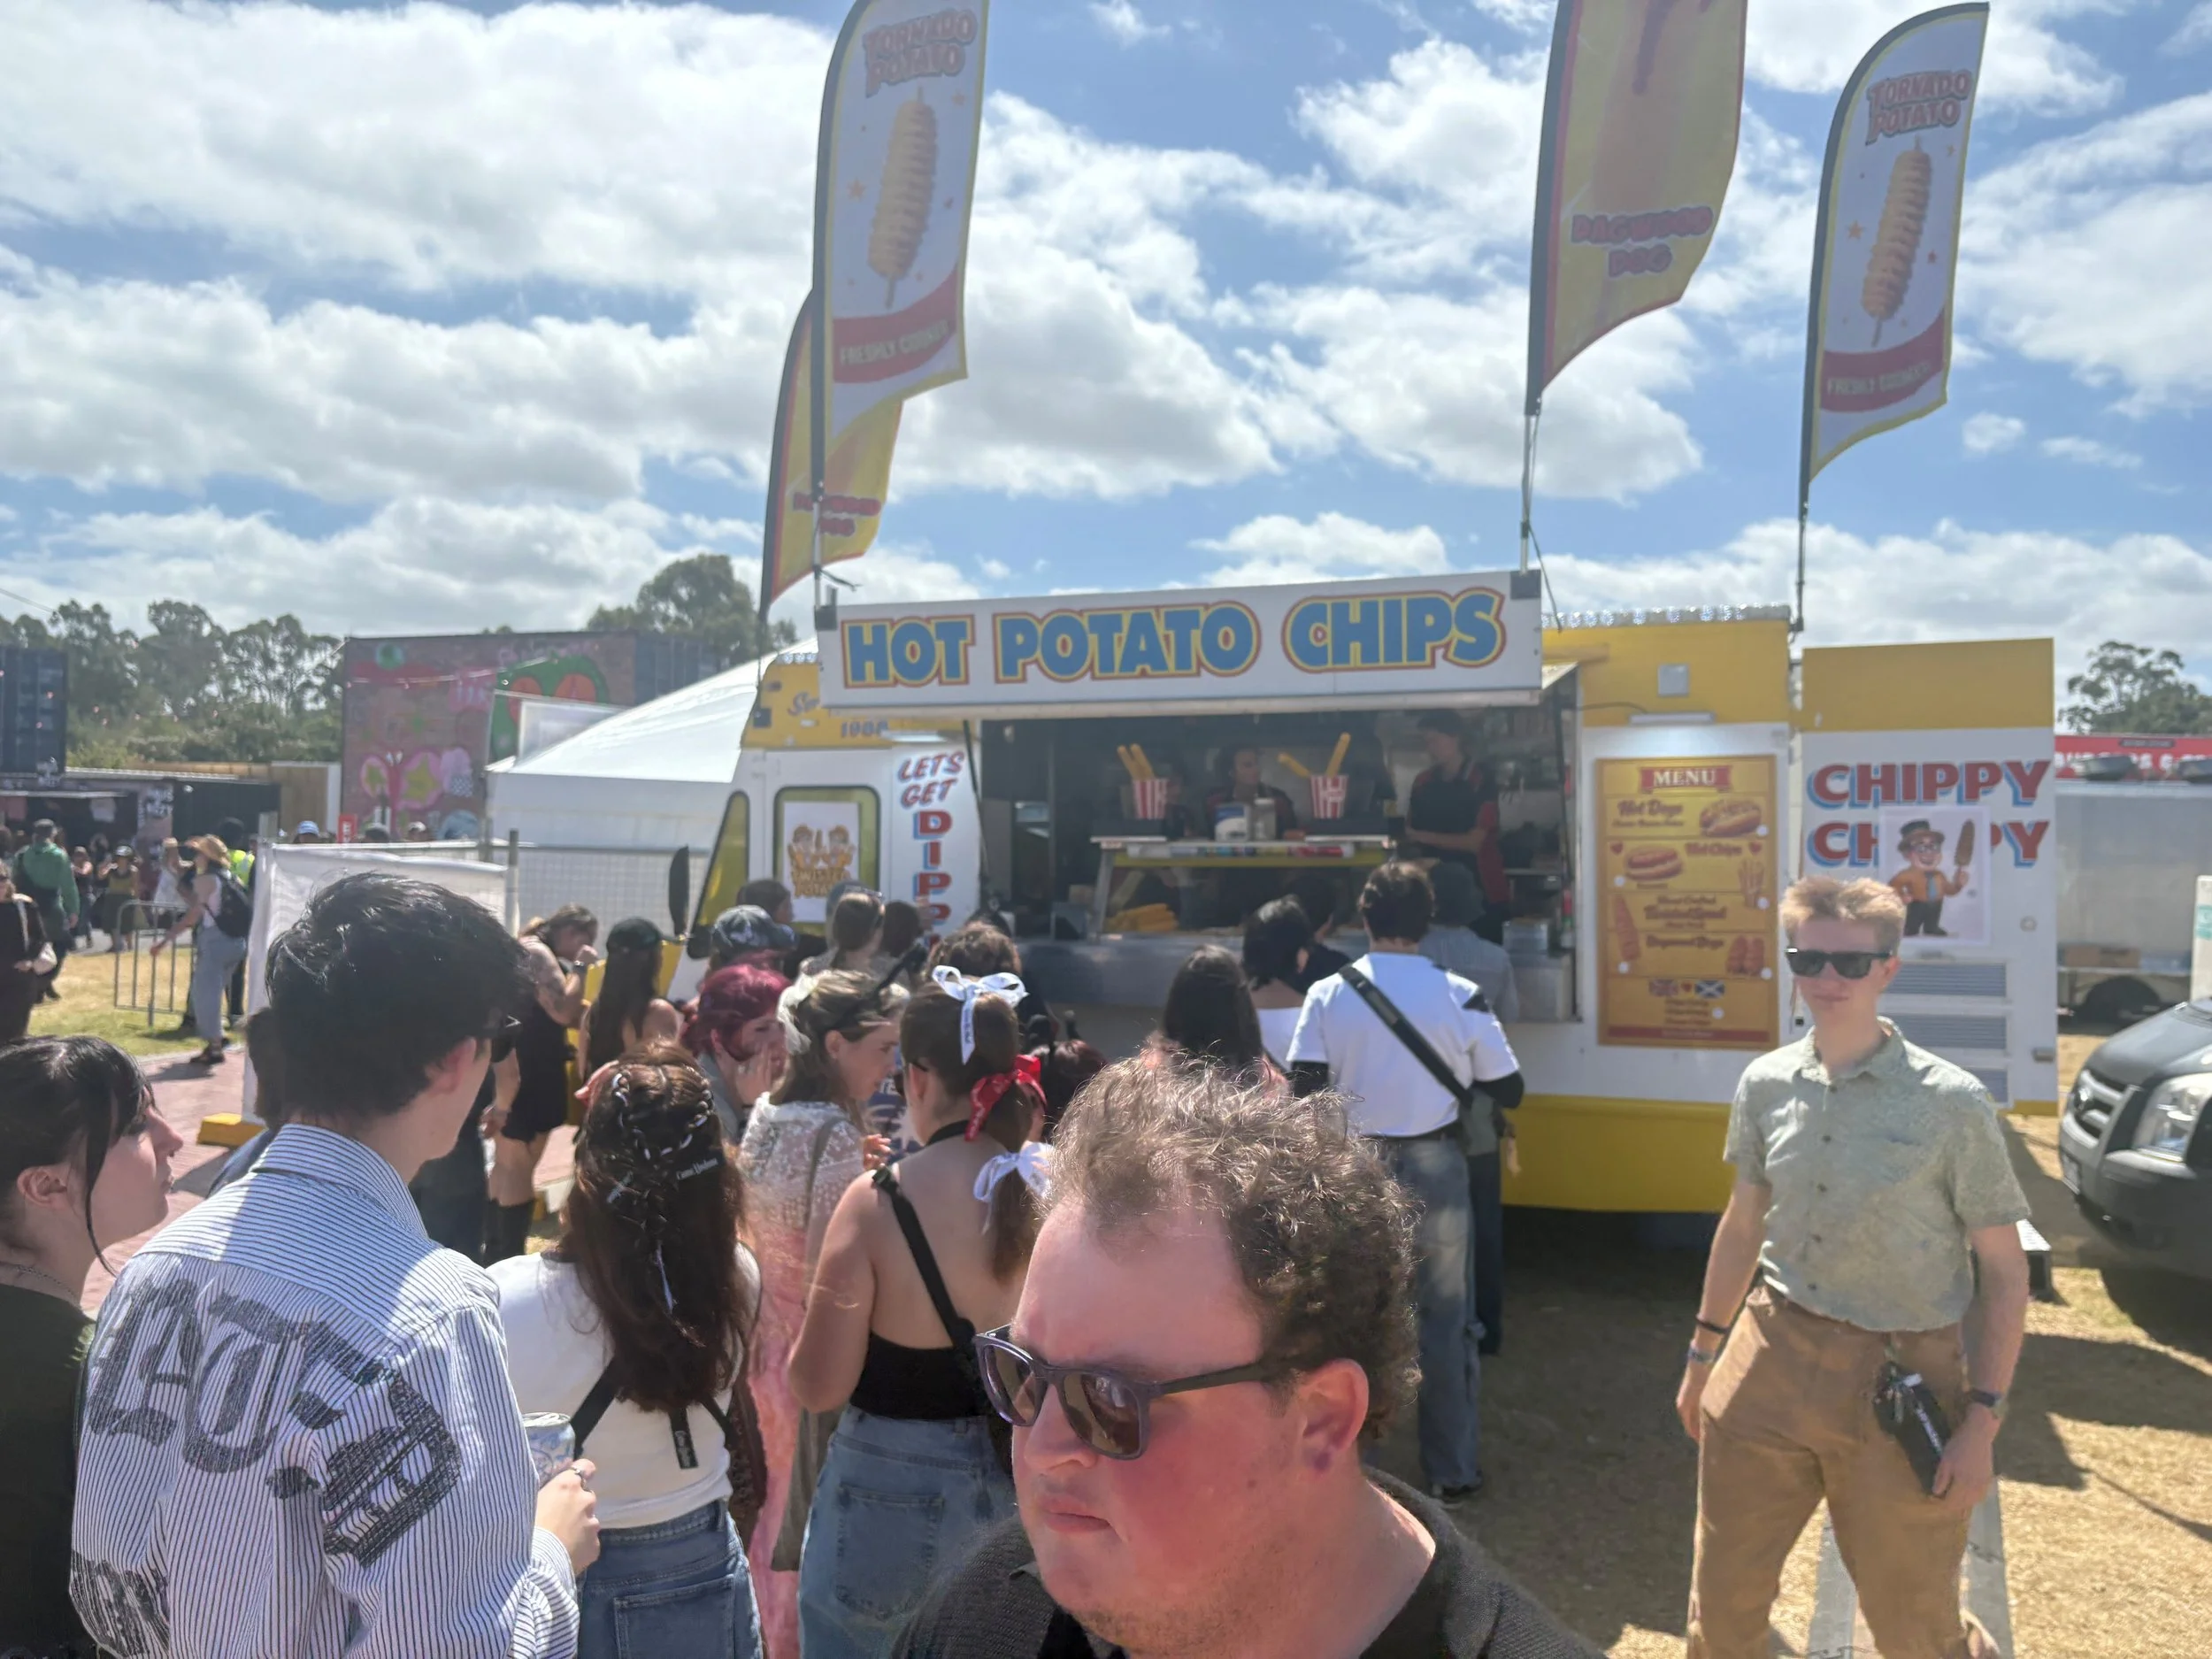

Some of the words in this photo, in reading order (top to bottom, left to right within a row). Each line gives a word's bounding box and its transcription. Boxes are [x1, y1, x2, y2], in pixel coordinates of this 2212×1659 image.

[1867, 70, 1971, 108] TORNADO
[1866, 97, 1961, 145] POTATO
[1571, 205, 1713, 244] DAGWOOD
[1609, 244, 1672, 278] DOG
[841, 615, 976, 687] HOT
[994, 600, 1263, 684] POTATO
[1282, 587, 1507, 674] CHIPS
[898, 750, 965, 782] LETS
[1653, 769, 1717, 787] MENU
[1806, 759, 2052, 810] CHIPPY
[901, 777, 957, 809] GET
[1806, 819, 2050, 869] CHY
